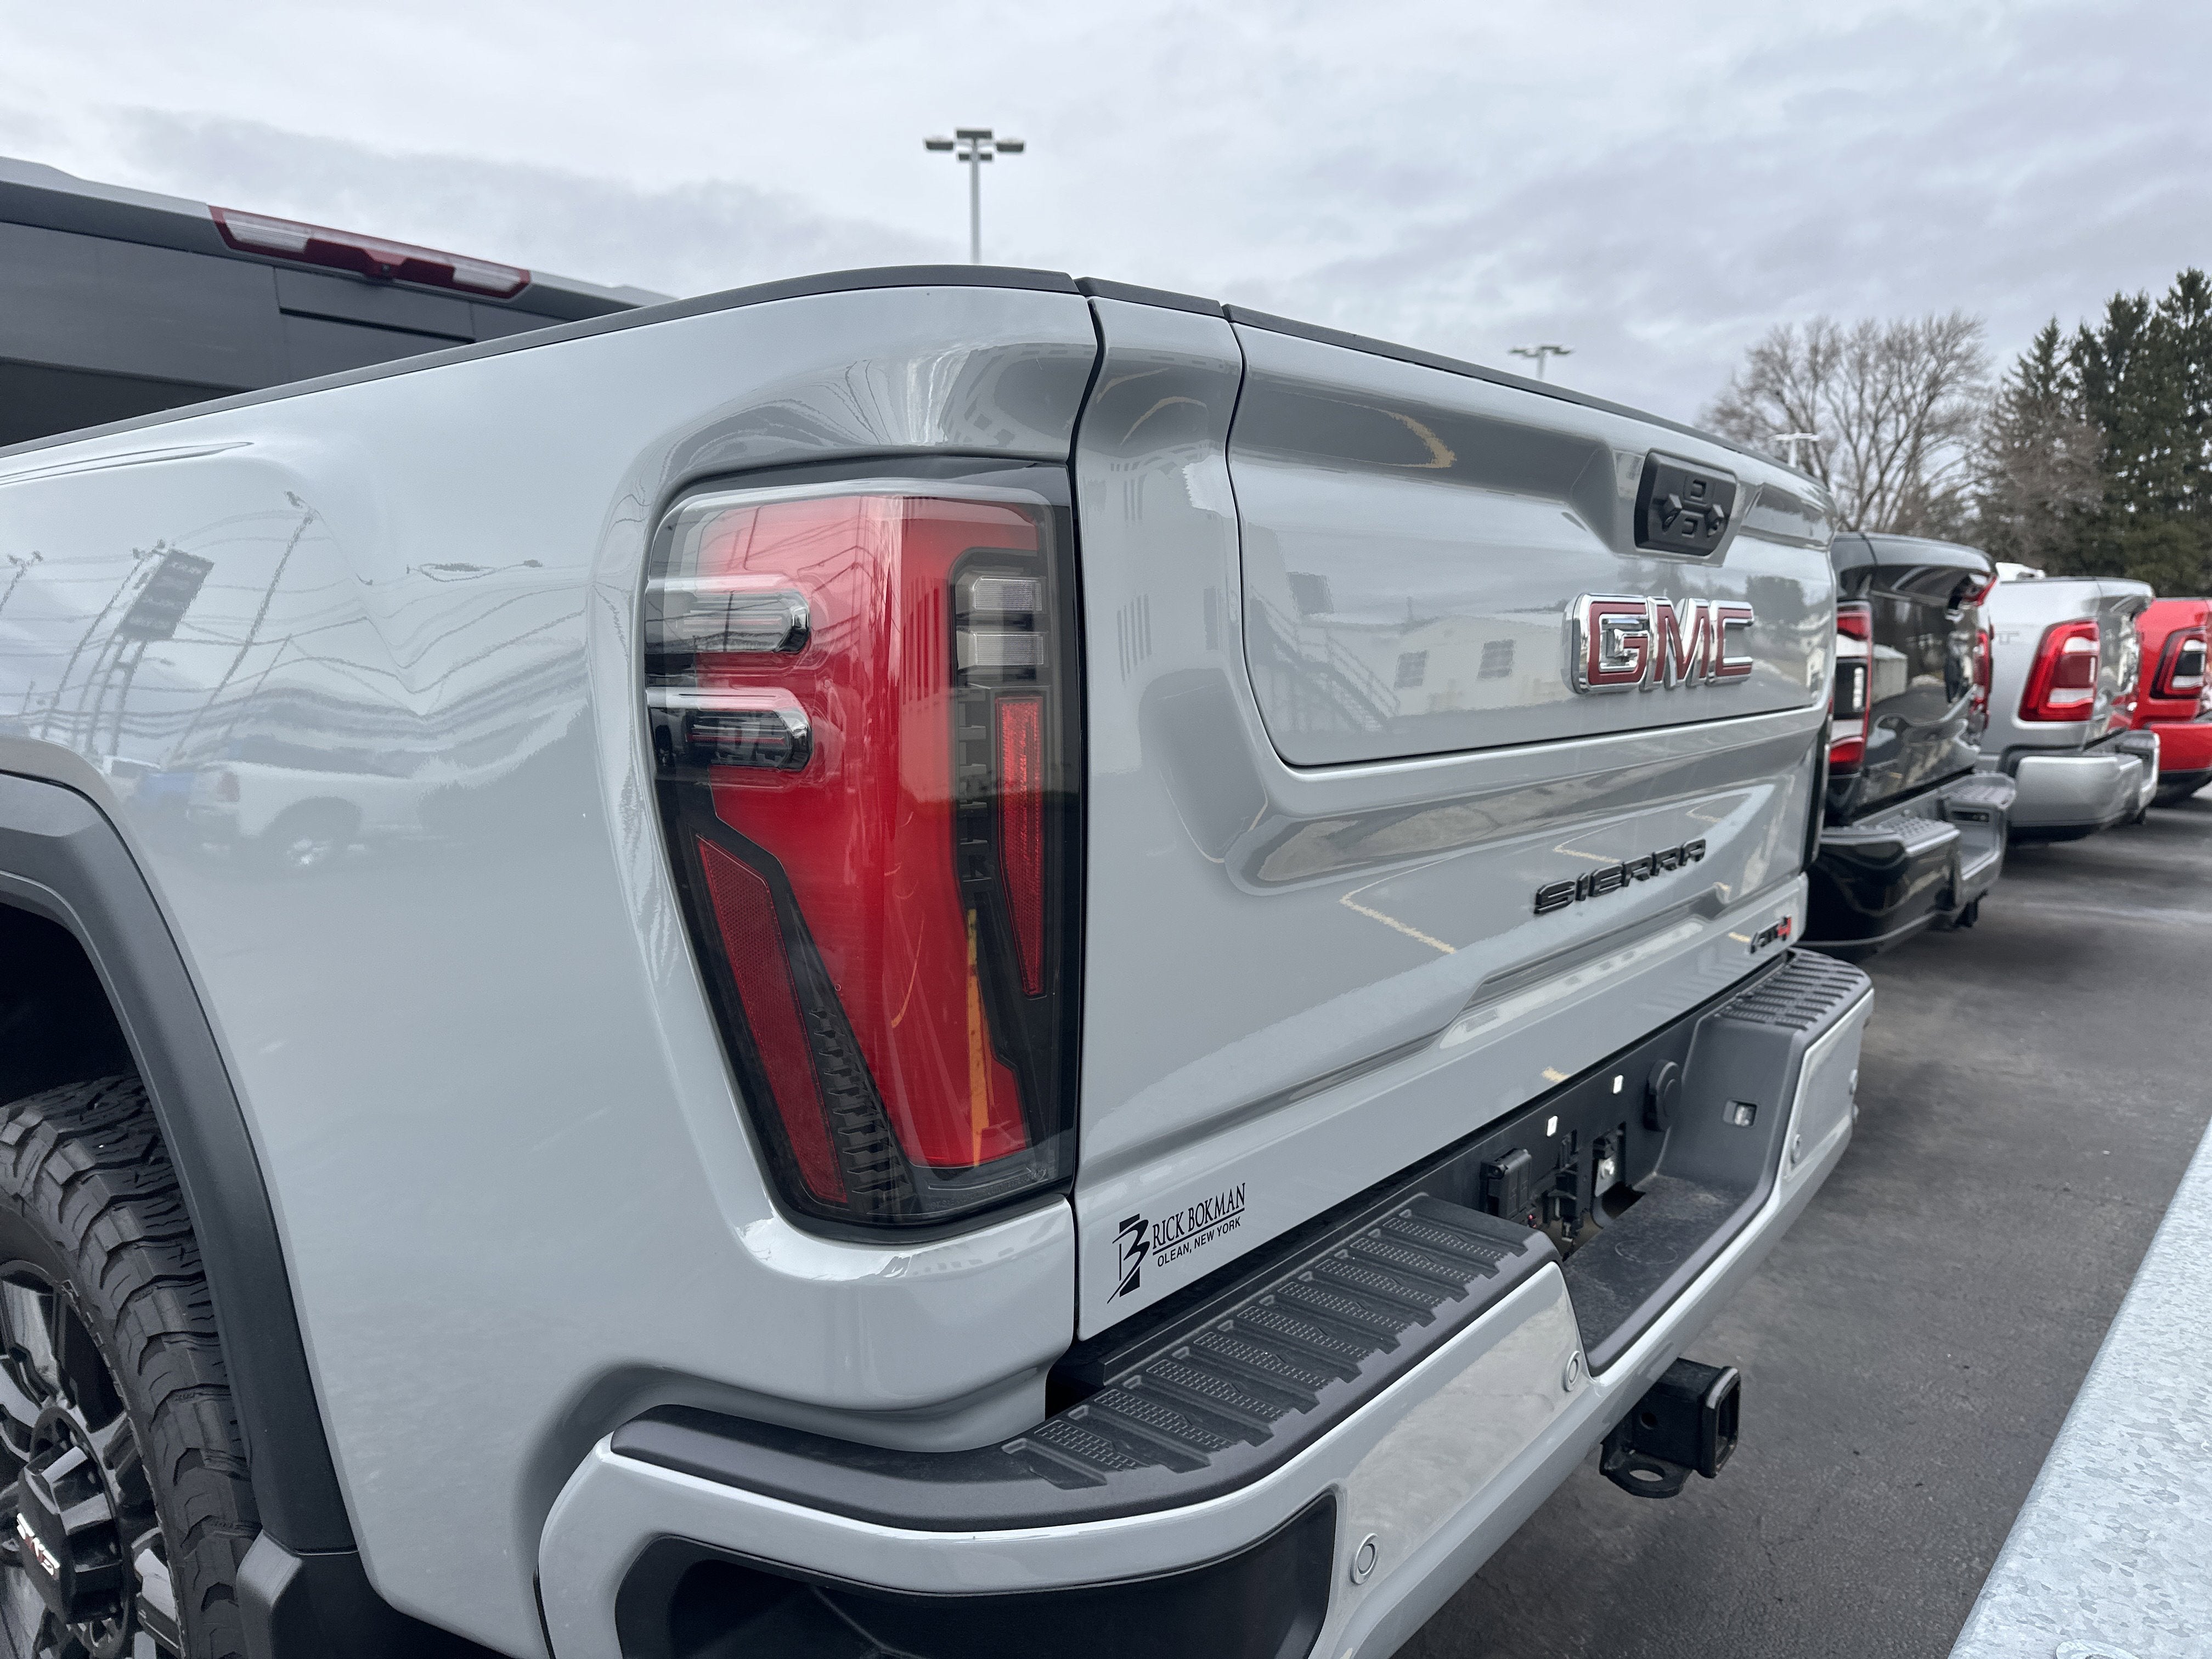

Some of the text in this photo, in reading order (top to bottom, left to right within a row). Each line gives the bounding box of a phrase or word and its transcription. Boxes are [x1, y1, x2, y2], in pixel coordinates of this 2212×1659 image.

[1561, 592, 1754, 695] GMC
[1534, 836, 1706, 914] SIERRA
[1152, 1211, 1184, 1250] RICK
[1188, 1182, 1245, 1232] BOKMAN
[1157, 1216, 1241, 1267] OLEAN, NEW YORK
